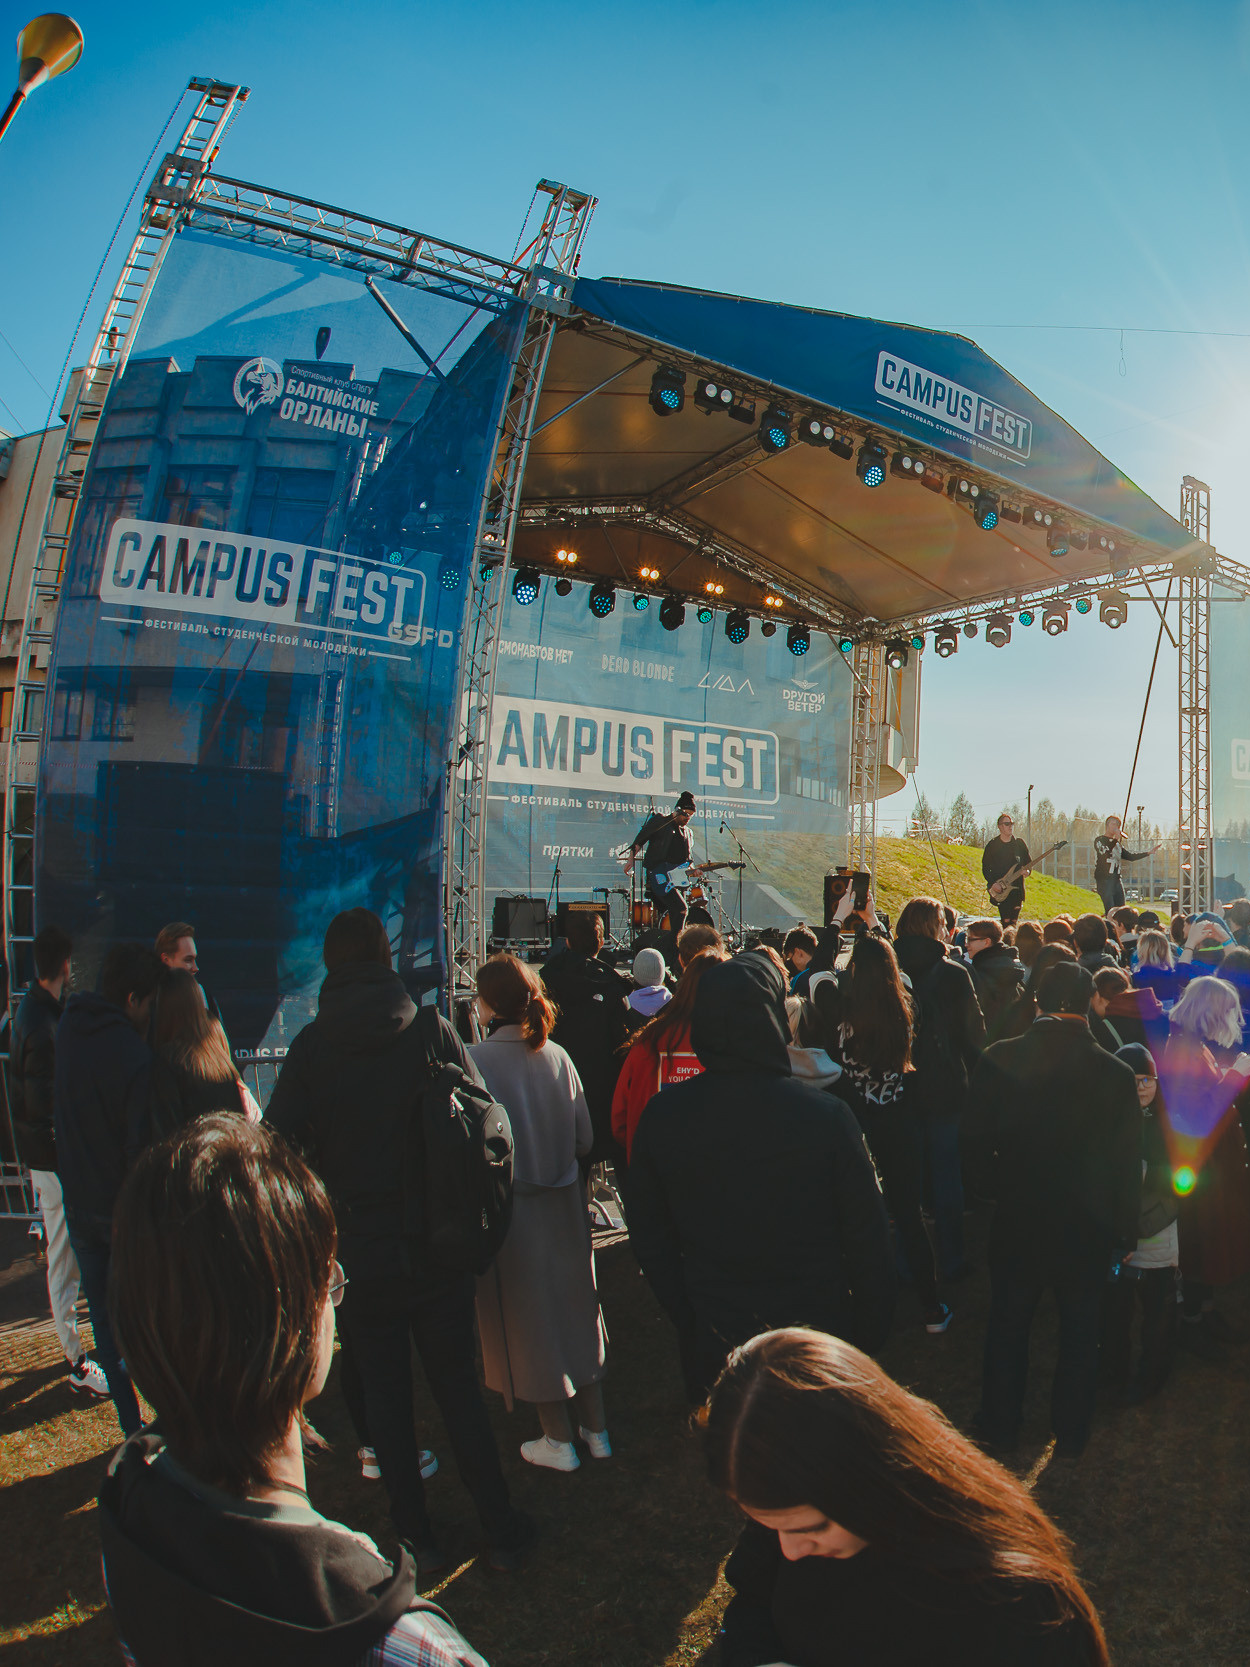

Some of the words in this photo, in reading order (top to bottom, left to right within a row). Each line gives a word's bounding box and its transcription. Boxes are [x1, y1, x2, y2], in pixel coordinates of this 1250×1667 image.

[291, 365, 334, 384] Спортивный
[285, 378, 380, 417] БАЛТИЙСКИЕ
[881, 359, 973, 424] CAMPUS
[978, 402, 1027, 449] FEST
[279, 398, 369, 439] ОРЛАНЫ
[112, 531, 295, 608] CAMPUS
[304, 558, 415, 628] FEST
[145, 618, 210, 634] ФЕСТИВАЛЬ
[213, 626, 300, 646] СТУДЕНЧЕСКОЙ
[303, 638, 367, 657] МОЛОДЕЖИ
[486, 639, 555, 661] СМОНАВТОВ
[555, 648, 574, 665] НЕТ
[601, 653, 630, 674] DEAD
[632, 659, 675, 682] BLONDE
[787, 700, 822, 714] ВЕТЕР
[671, 728, 768, 791] FEST
[511, 794, 583, 809] ФЕСТИВАЛЬ
